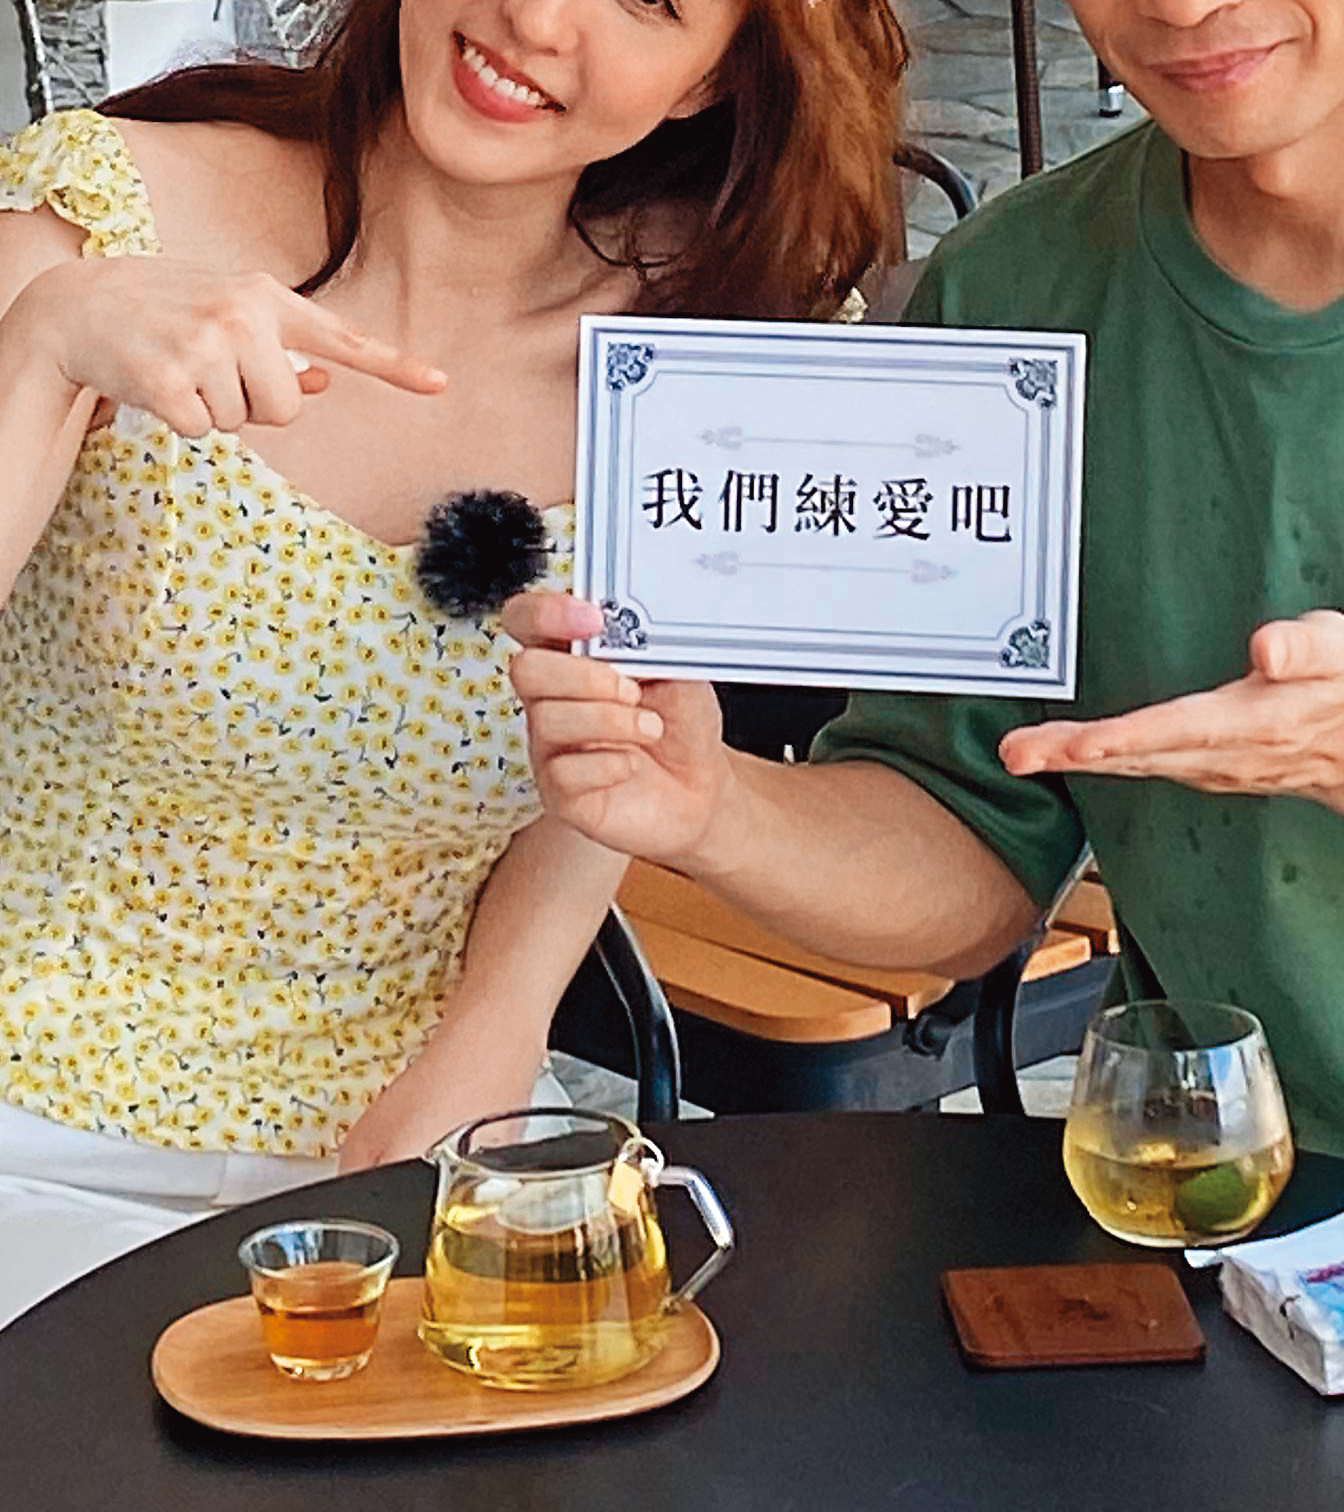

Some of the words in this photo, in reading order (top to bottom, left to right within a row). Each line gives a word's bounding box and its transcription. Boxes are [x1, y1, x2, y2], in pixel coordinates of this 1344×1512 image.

[642, 468, 1012, 542] 我們練愛吧
